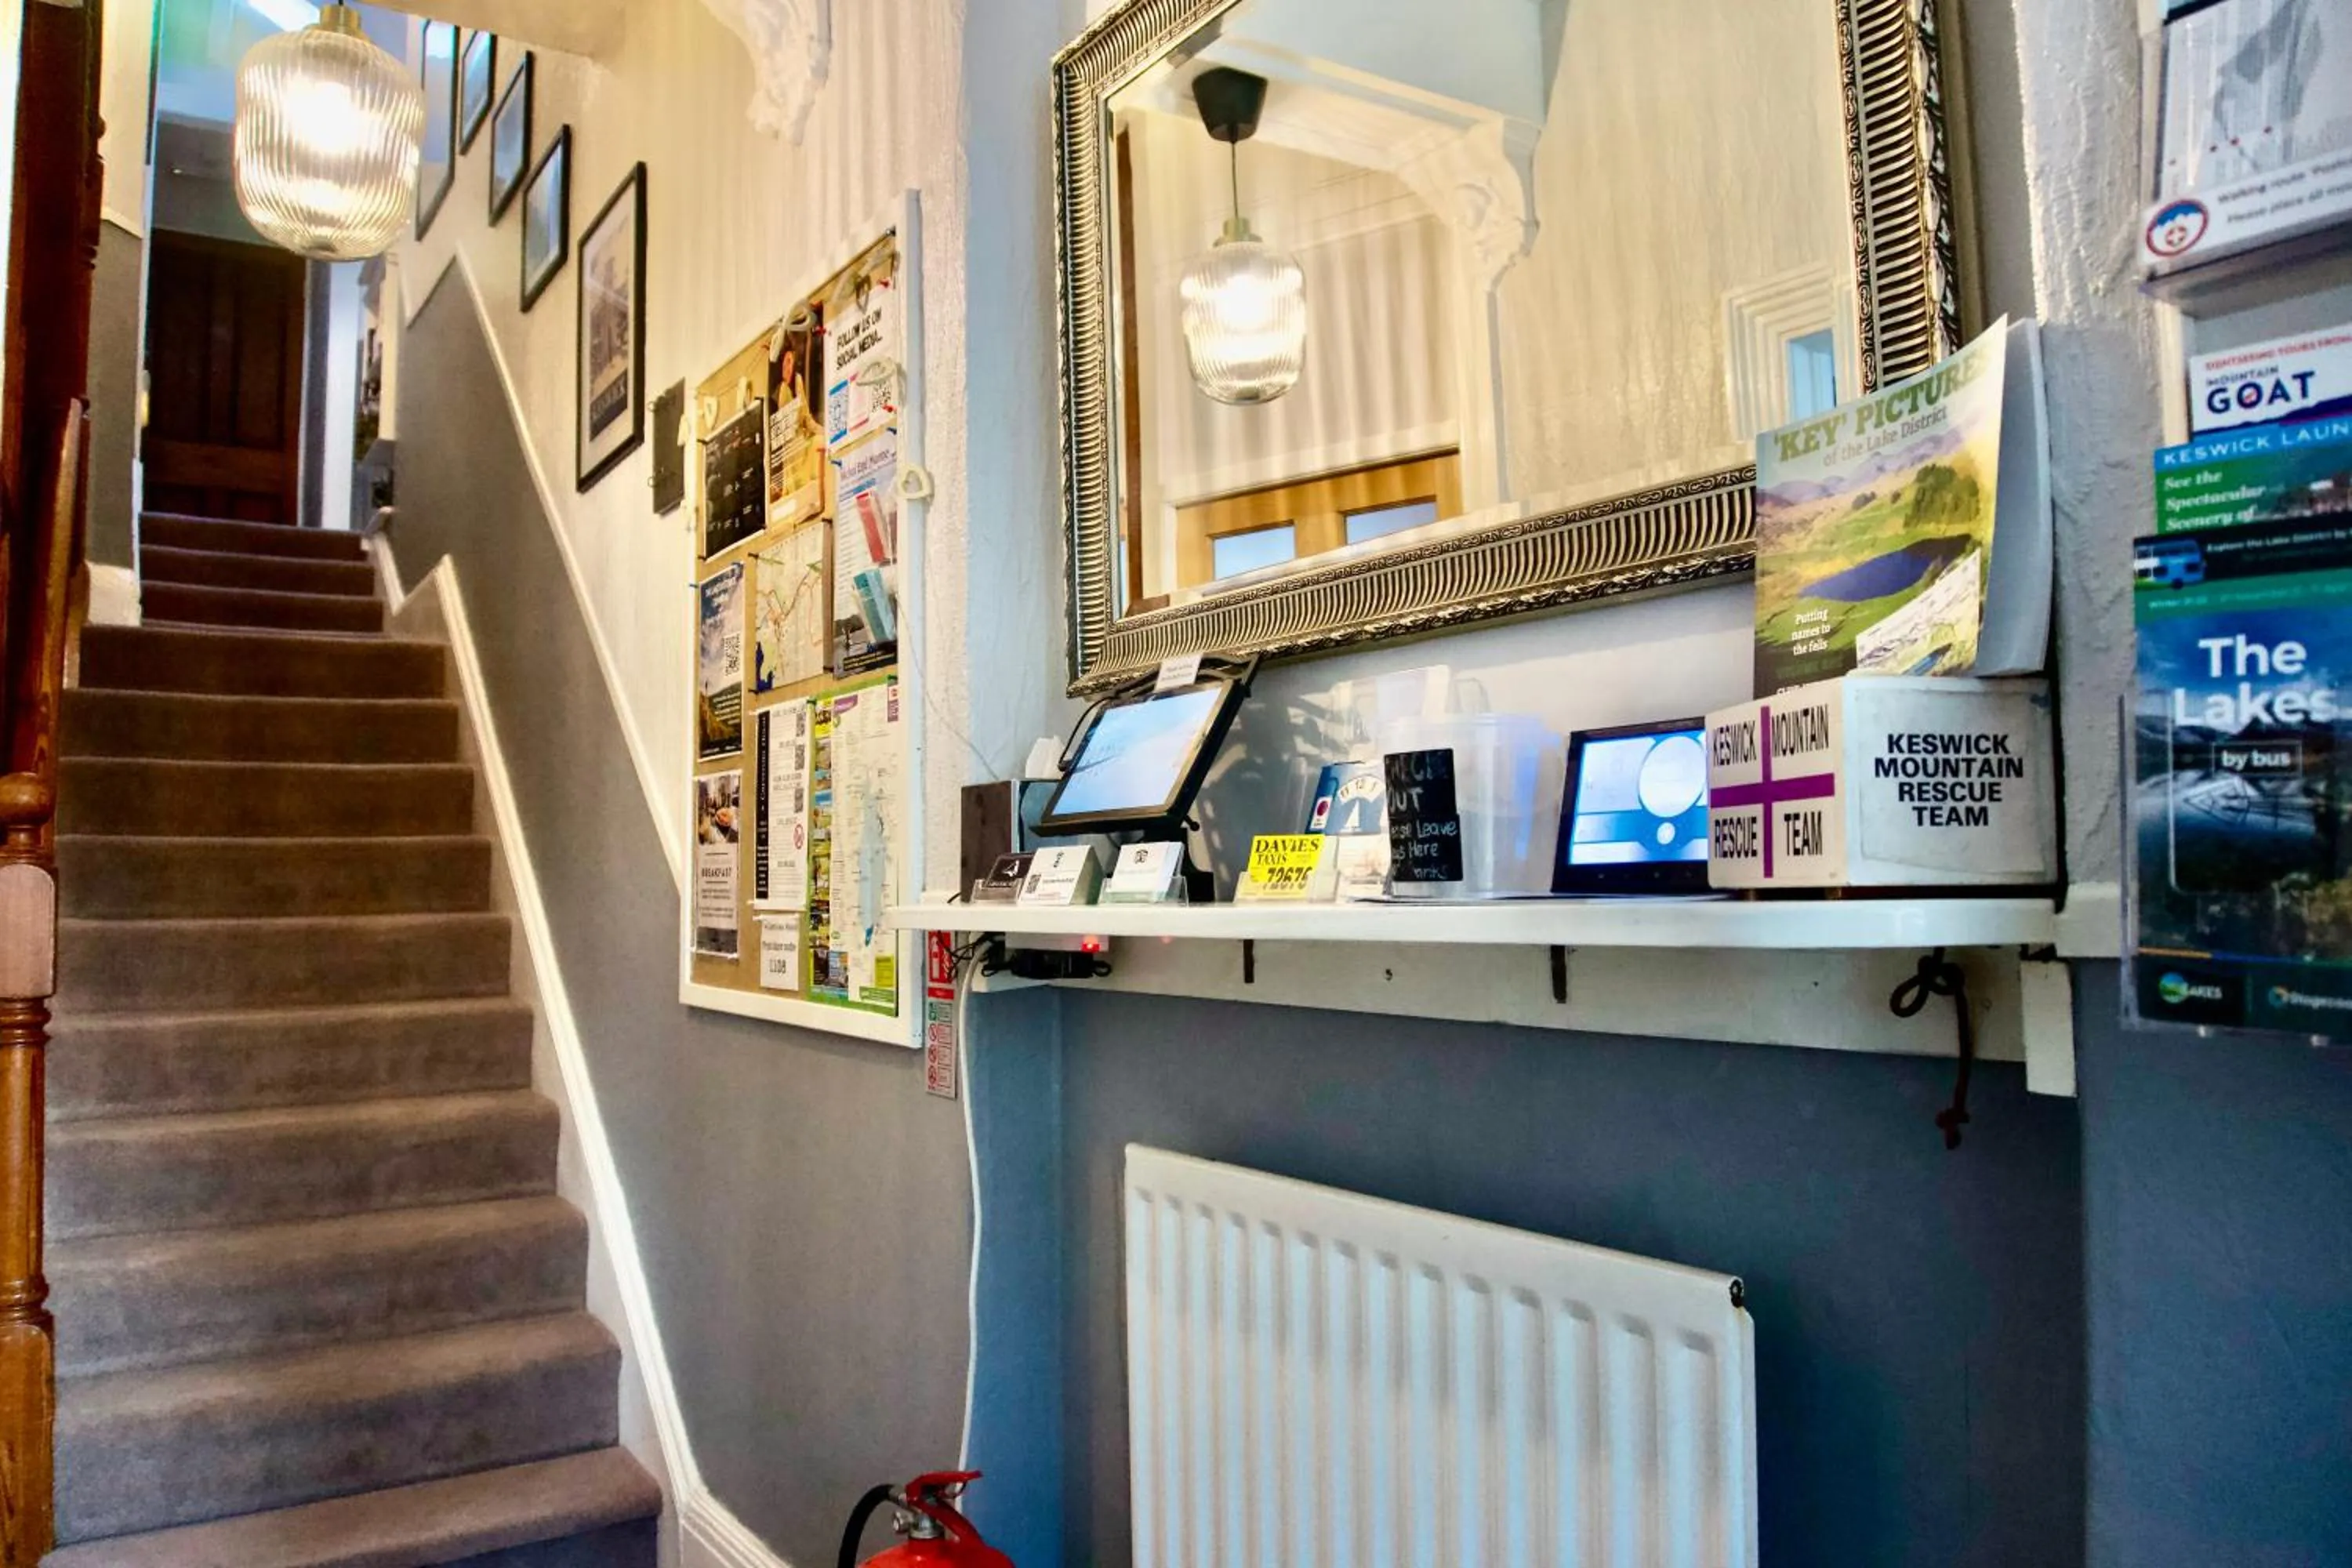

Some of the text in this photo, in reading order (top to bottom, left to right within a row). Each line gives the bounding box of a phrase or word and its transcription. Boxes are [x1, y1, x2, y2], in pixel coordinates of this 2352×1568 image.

[2207, 365, 2279, 386] MOUNTAIN
[2207, 371, 2315, 414] GOAT
[1824, 405, 1947, 466] of the Lake District
[2164, 436, 2270, 465] KESWICK
[2165, 470, 2223, 491] See the
[2166, 485, 2267, 512] Spectacular
[2166, 503, 2258, 531] Scenery of
[1791, 625, 1830, 641] names to
[1793, 643, 1806, 655] the
[2198, 633, 2307, 677] The
[2174, 682, 2337, 726] Lakes
[1713, 704, 1829, 767] KESWICK MOUNTAIN
[1888, 734, 2009, 754] KESWICK
[1875, 757, 2023, 778] MOUNTAIN
[2222, 750, 2290, 769] by bus
[1898, 782, 2002, 802] RESCUE
[1911, 807, 1988, 826] TEAM
[1416, 819, 1457, 838] Leave
[1715, 811, 1823, 858] RESCUE TEAM
[1254, 838, 1319, 853] DAVIES
[1408, 840, 1439, 858] Here
[1257, 853, 1288, 866] TAXIS
